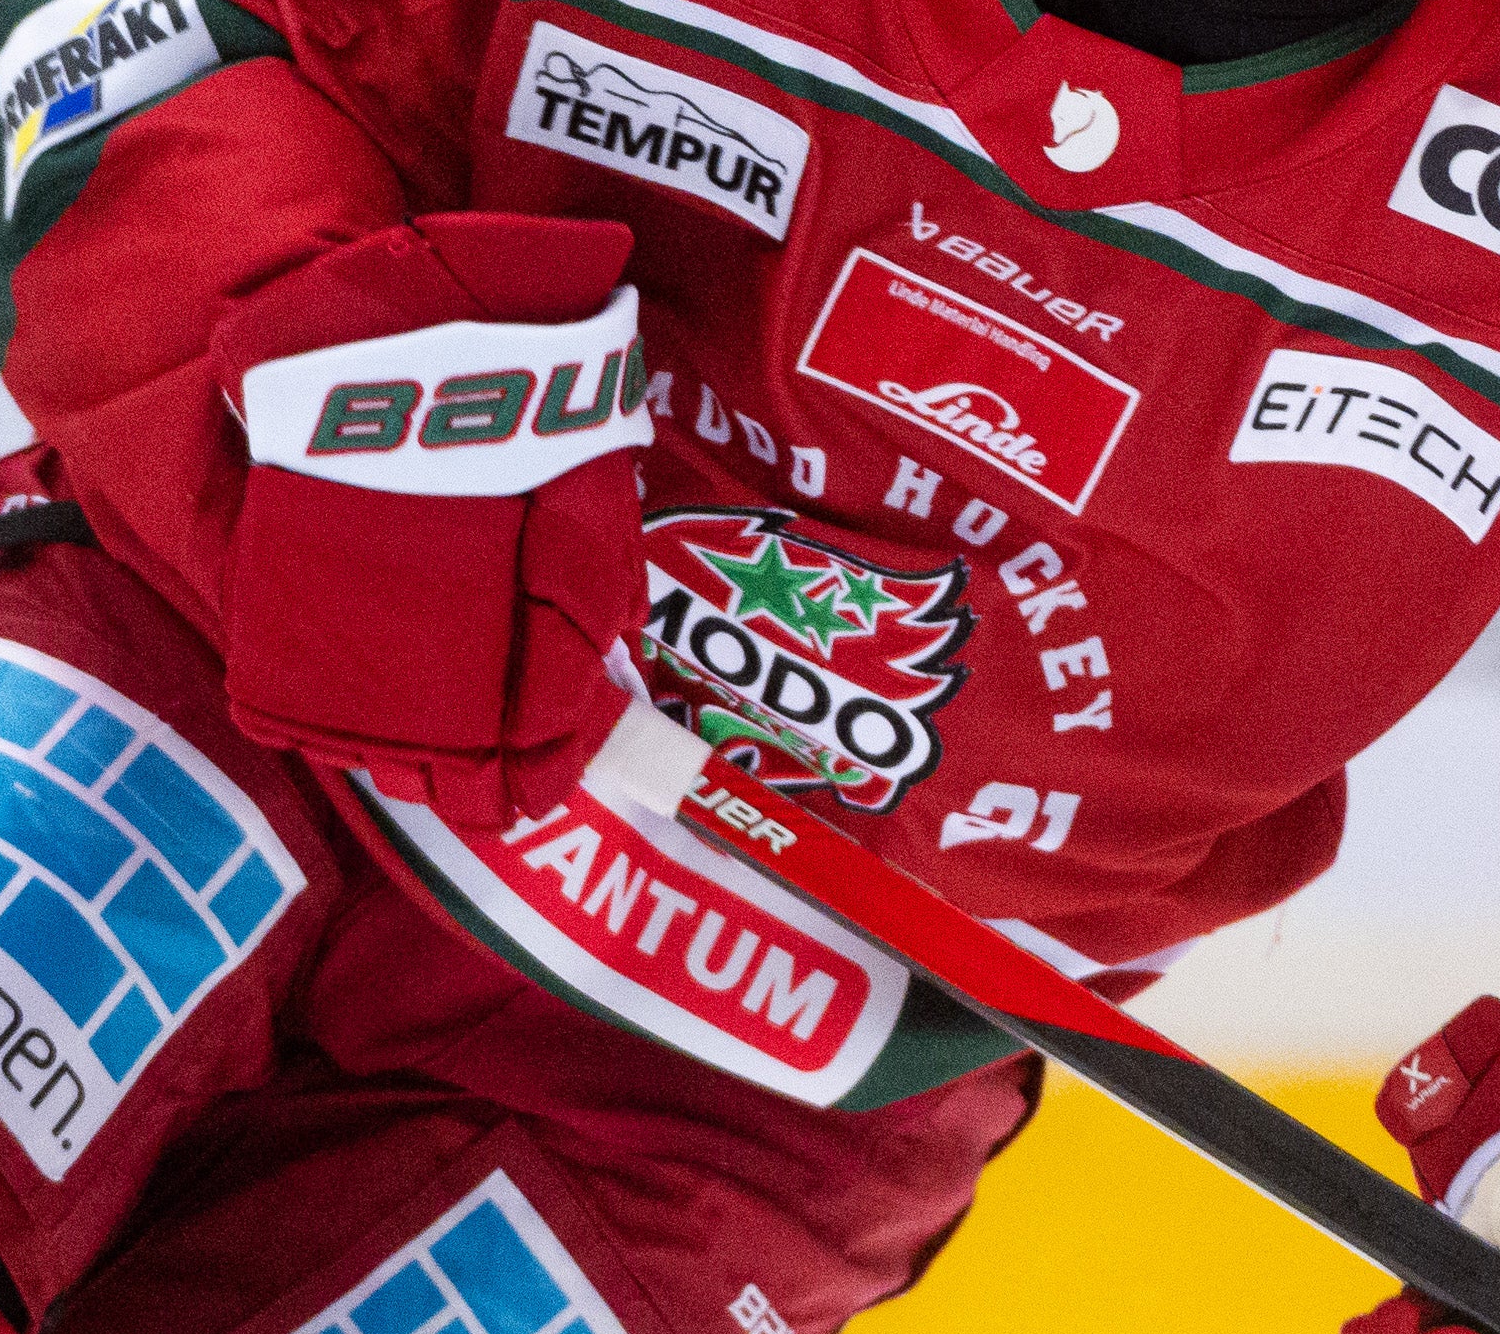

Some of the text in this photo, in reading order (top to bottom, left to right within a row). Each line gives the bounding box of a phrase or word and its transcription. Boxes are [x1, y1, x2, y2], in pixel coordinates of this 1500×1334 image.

[533, 86, 785, 220] TEMPUR
[877, 380, 1048, 475] Linde
[883, 454, 1113, 733] HOCKEY
